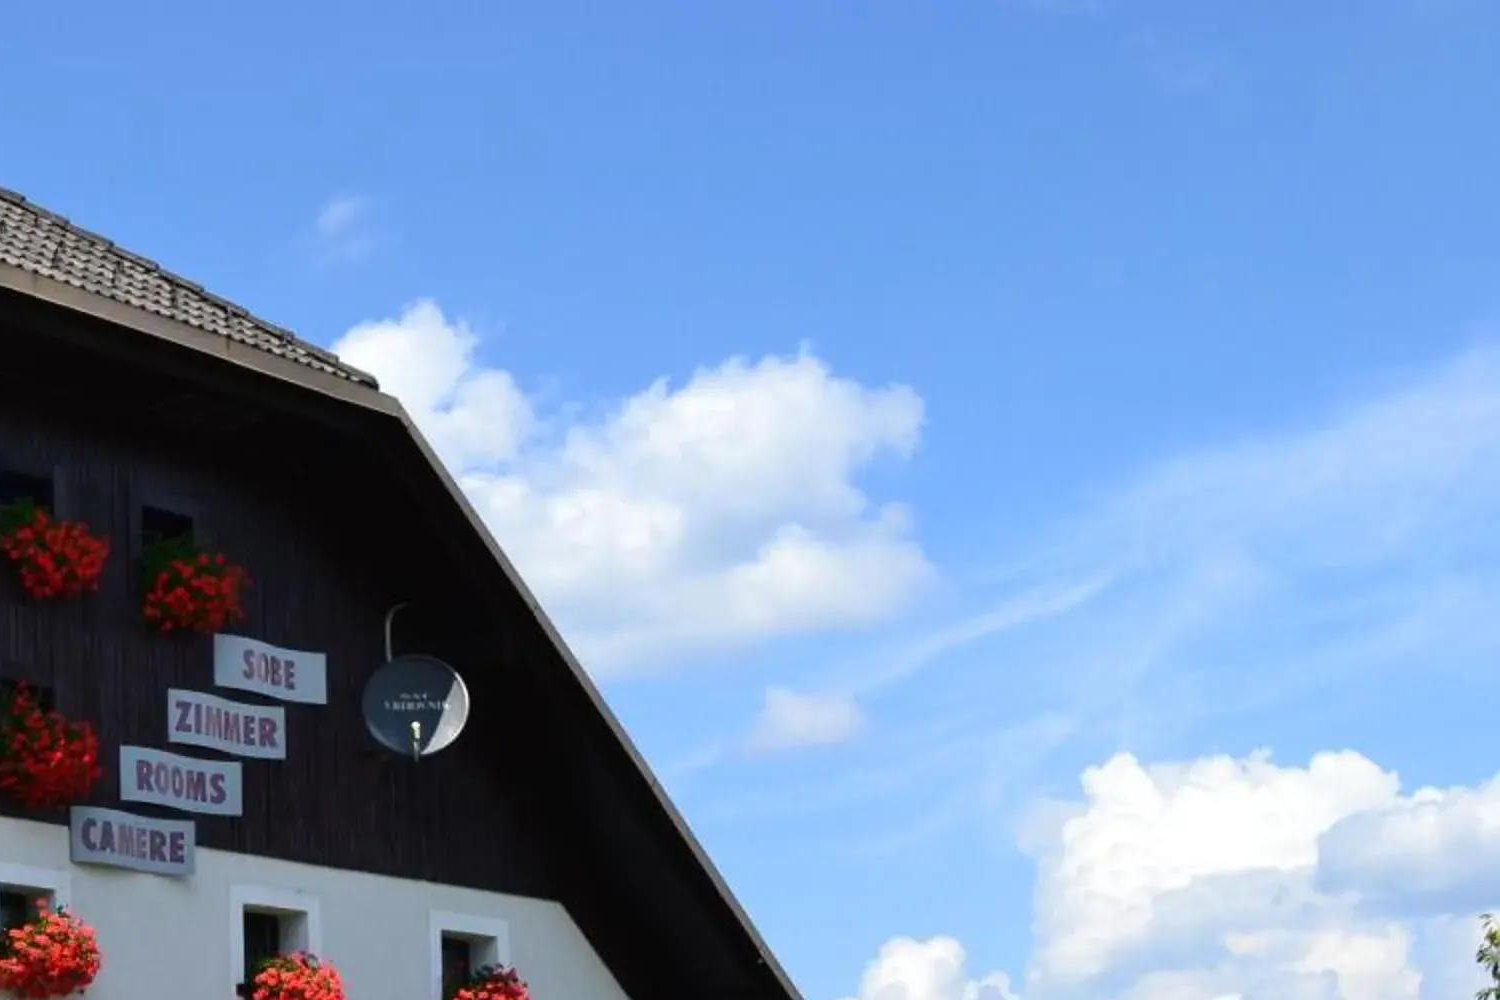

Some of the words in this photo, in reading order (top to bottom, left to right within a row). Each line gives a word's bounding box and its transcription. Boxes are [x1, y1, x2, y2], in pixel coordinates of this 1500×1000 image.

[242, 648, 296, 691] SOBE
[174, 700, 279, 748] ZIMMER
[135, 758, 227, 805] ROOMS
[81, 816, 185, 865] CAMERE
